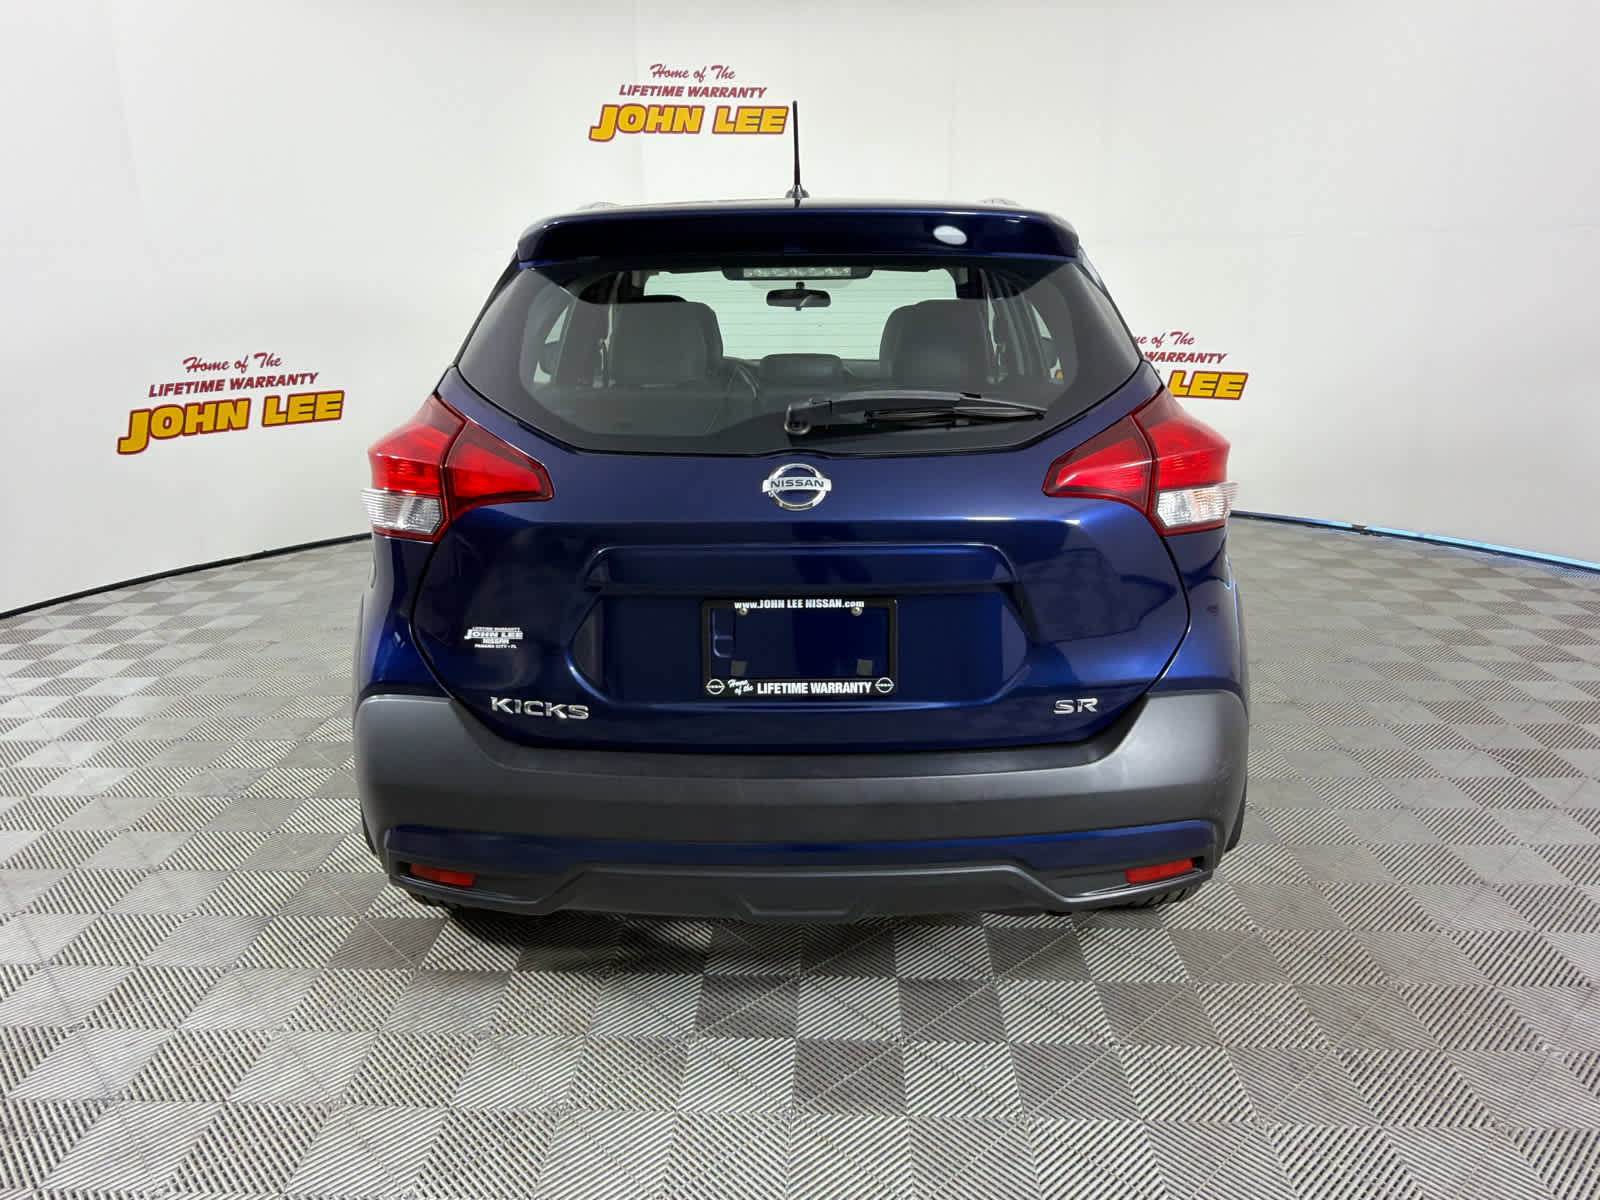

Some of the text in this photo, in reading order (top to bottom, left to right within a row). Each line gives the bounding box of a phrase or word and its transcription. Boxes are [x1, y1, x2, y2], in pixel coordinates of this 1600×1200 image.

[650, 63, 736, 83] Home of The
[619, 84, 767, 99] LIFETIME WARRANTY
[588, 103, 789, 142] JOHN LEE
[1151, 332, 1166, 349] of
[1170, 331, 1195, 346] The
[182, 352, 282, 374] Home of The
[1144, 352, 1227, 364] WARRANTY
[148, 372, 319, 398] LIFETIME WARRANTY
[1168, 370, 1249, 400] LEE
[117, 390, 345, 455] JOHN LEE
[770, 479, 824, 488] NISSAN
[734, 598, 865, 609] www.JOHN LEE NISSAN.com
[464, 629, 524, 640] JOHN LEE
[757, 681, 872, 695] LIFETIME WARRANTY
[490, 696, 589, 720] KICKS
[1053, 698, 1099, 715] SR
